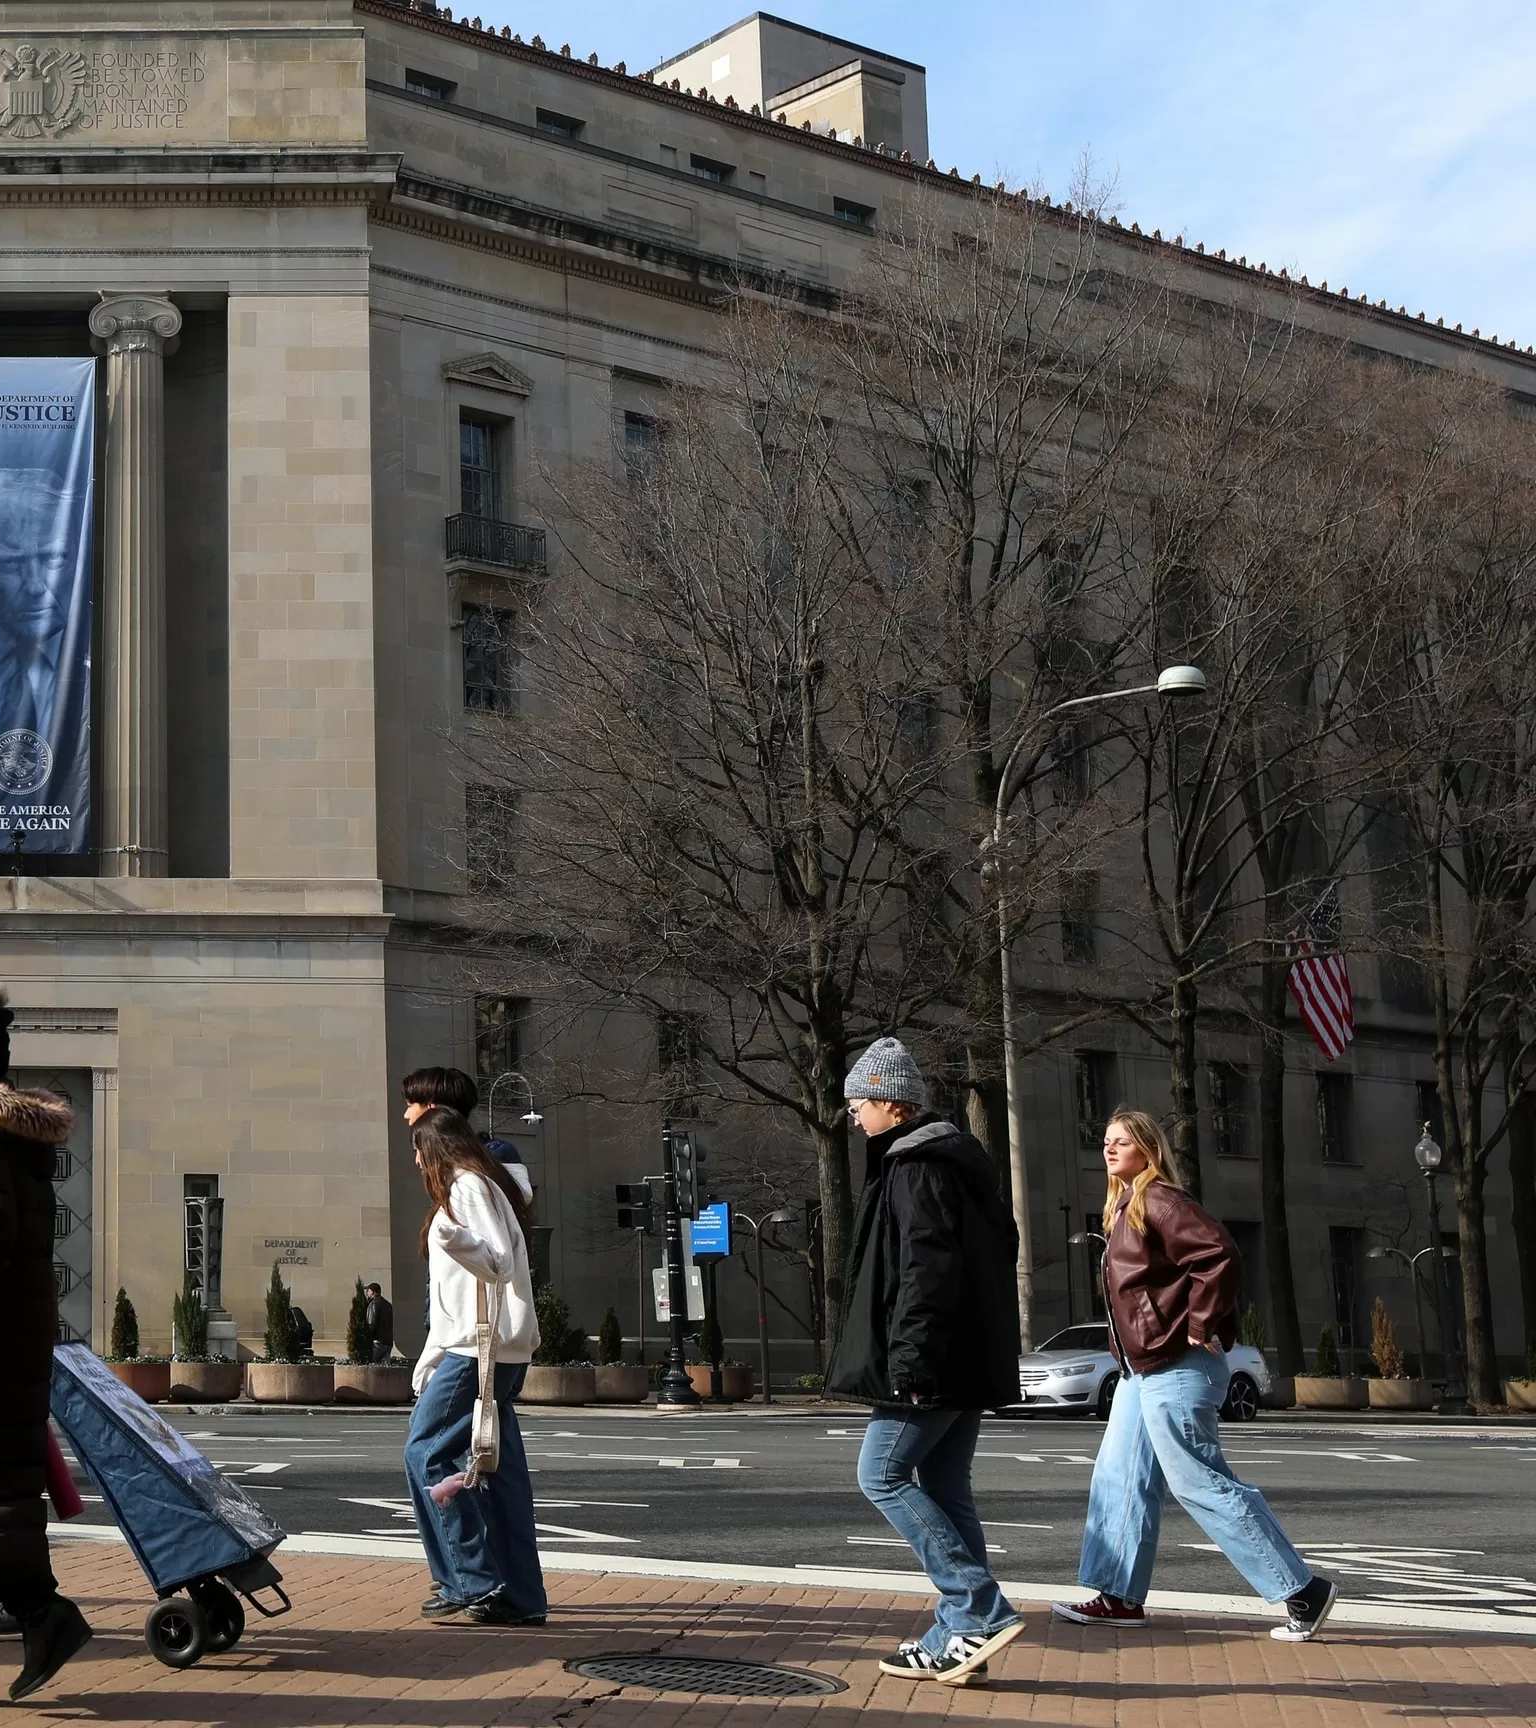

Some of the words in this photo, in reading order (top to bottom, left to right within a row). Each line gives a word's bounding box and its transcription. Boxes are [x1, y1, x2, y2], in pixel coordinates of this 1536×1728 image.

[92, 52, 179, 67] FOUNDED
[189, 52, 206, 67] IN
[91, 68, 205, 82] BESTOWED
[82, 83, 134, 98] UPON
[144, 83, 189, 98] MAN.
[83, 99, 188, 114] MAINTAINED
[80, 114, 104, 129] OF
[112, 114, 188, 129] JUSTICE.
[62, 395, 76, 403] OF
[8, 804, 71, 815] AMERICA
[14, 817, 71, 831] AGAIN
[264, 1239, 319, 1248] DEPARTMENT
[285, 1249, 297, 1257] OF
